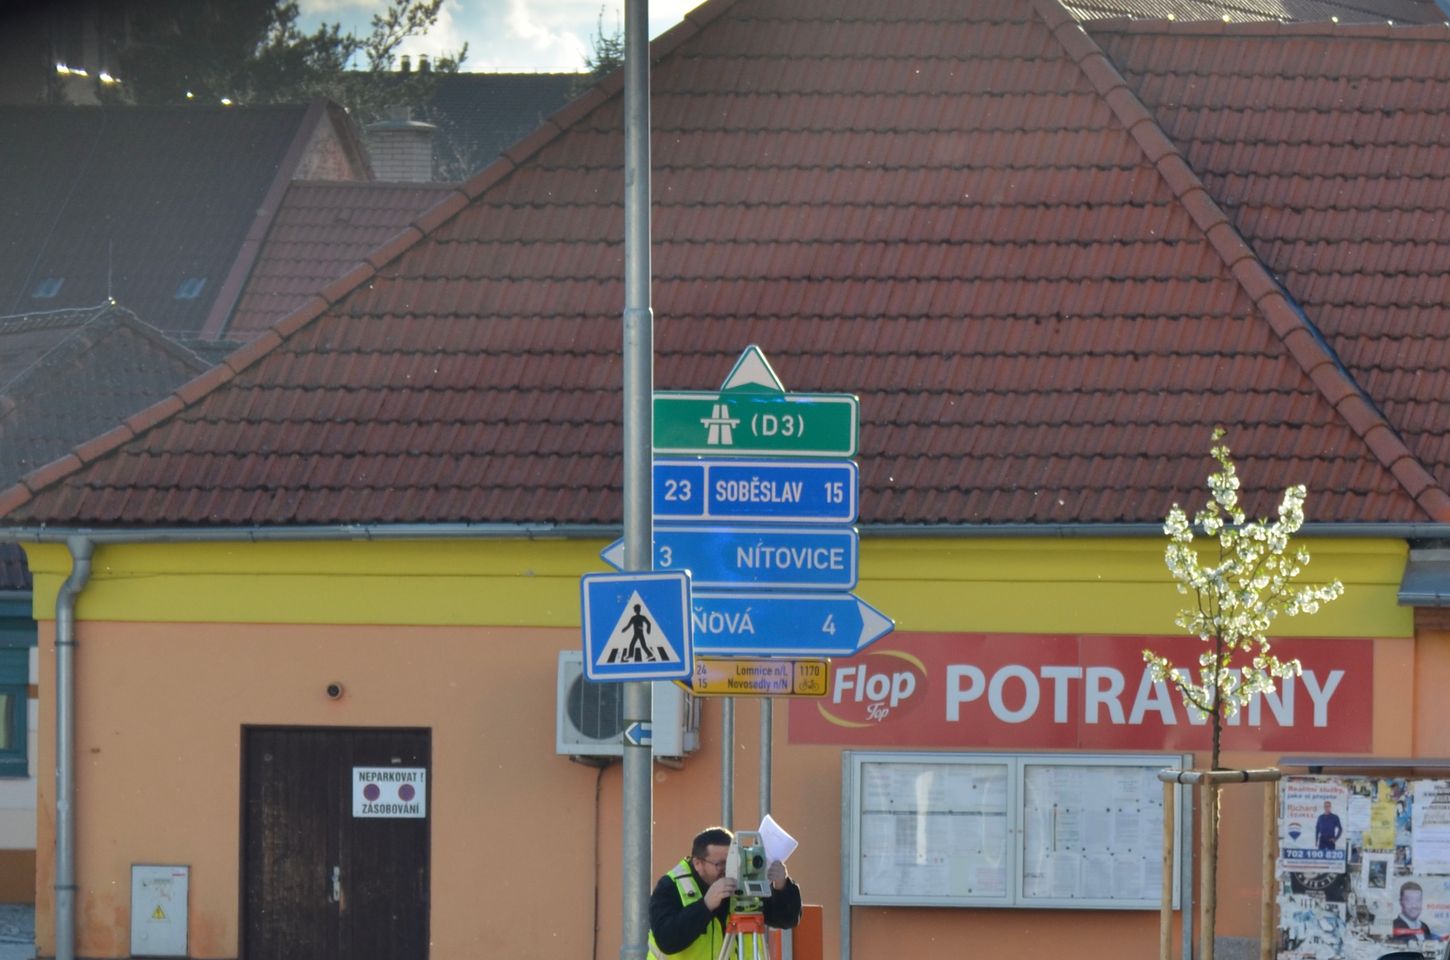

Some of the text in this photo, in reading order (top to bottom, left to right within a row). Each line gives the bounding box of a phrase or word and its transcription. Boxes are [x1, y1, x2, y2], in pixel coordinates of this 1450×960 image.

[664, 472, 844, 504] 23 SOBĚSLAV 15
[659, 538, 844, 570] 3 NÍTOVICE
[822, 613, 836, 635] 4
[696, 665, 820, 677] 24 Lomnice n/L 1170
[698, 678, 788, 691] 15 Novosedly n/N
[833, 664, 916, 708] Flop
[865, 702, 889, 721] Top
[358, 772, 417, 782] NEPARKOVAT
[361, 801, 419, 814] ZÁSOBOVÁNÍ
